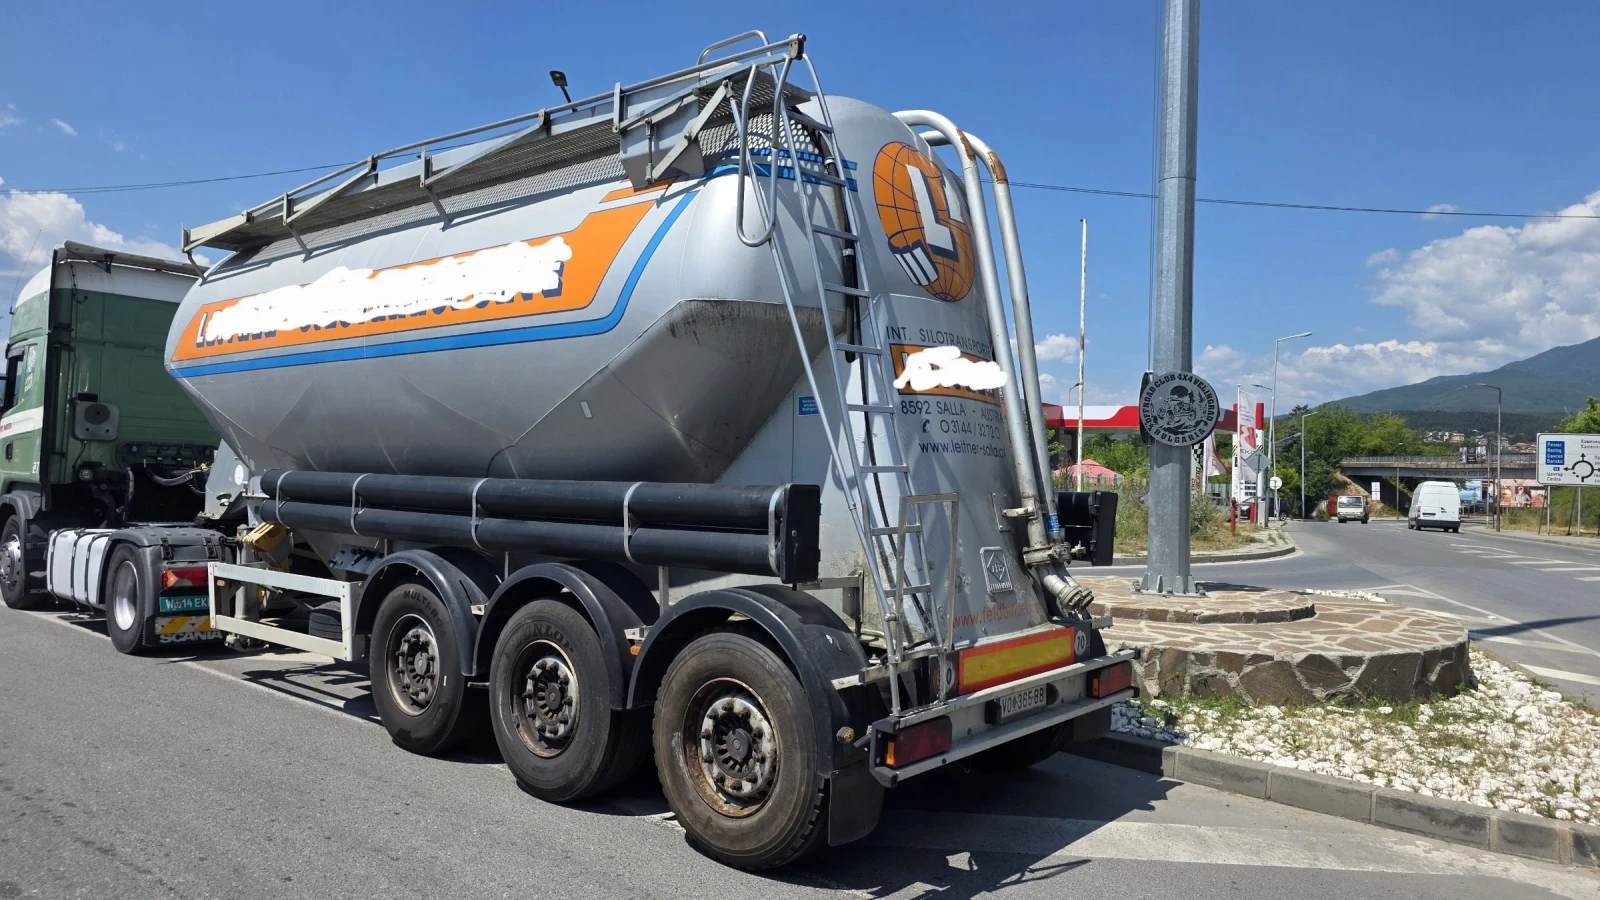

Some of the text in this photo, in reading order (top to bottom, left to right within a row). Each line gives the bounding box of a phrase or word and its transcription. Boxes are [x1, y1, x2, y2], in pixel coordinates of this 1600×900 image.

[886, 326, 912, 341] INT.
[1142, 386, 1157, 423] OFFROAD
[1154, 374, 1176, 388] CLUB
[1193, 378, 1215, 421] VELINGRAD
[901, 400, 932, 415] 8592
[937, 401, 967, 417] SALLA
[1154, 428, 1206, 443] BULGARIA
[160, 631, 223, 644] SCANIA
[1077, 635, 1085, 651] 70
